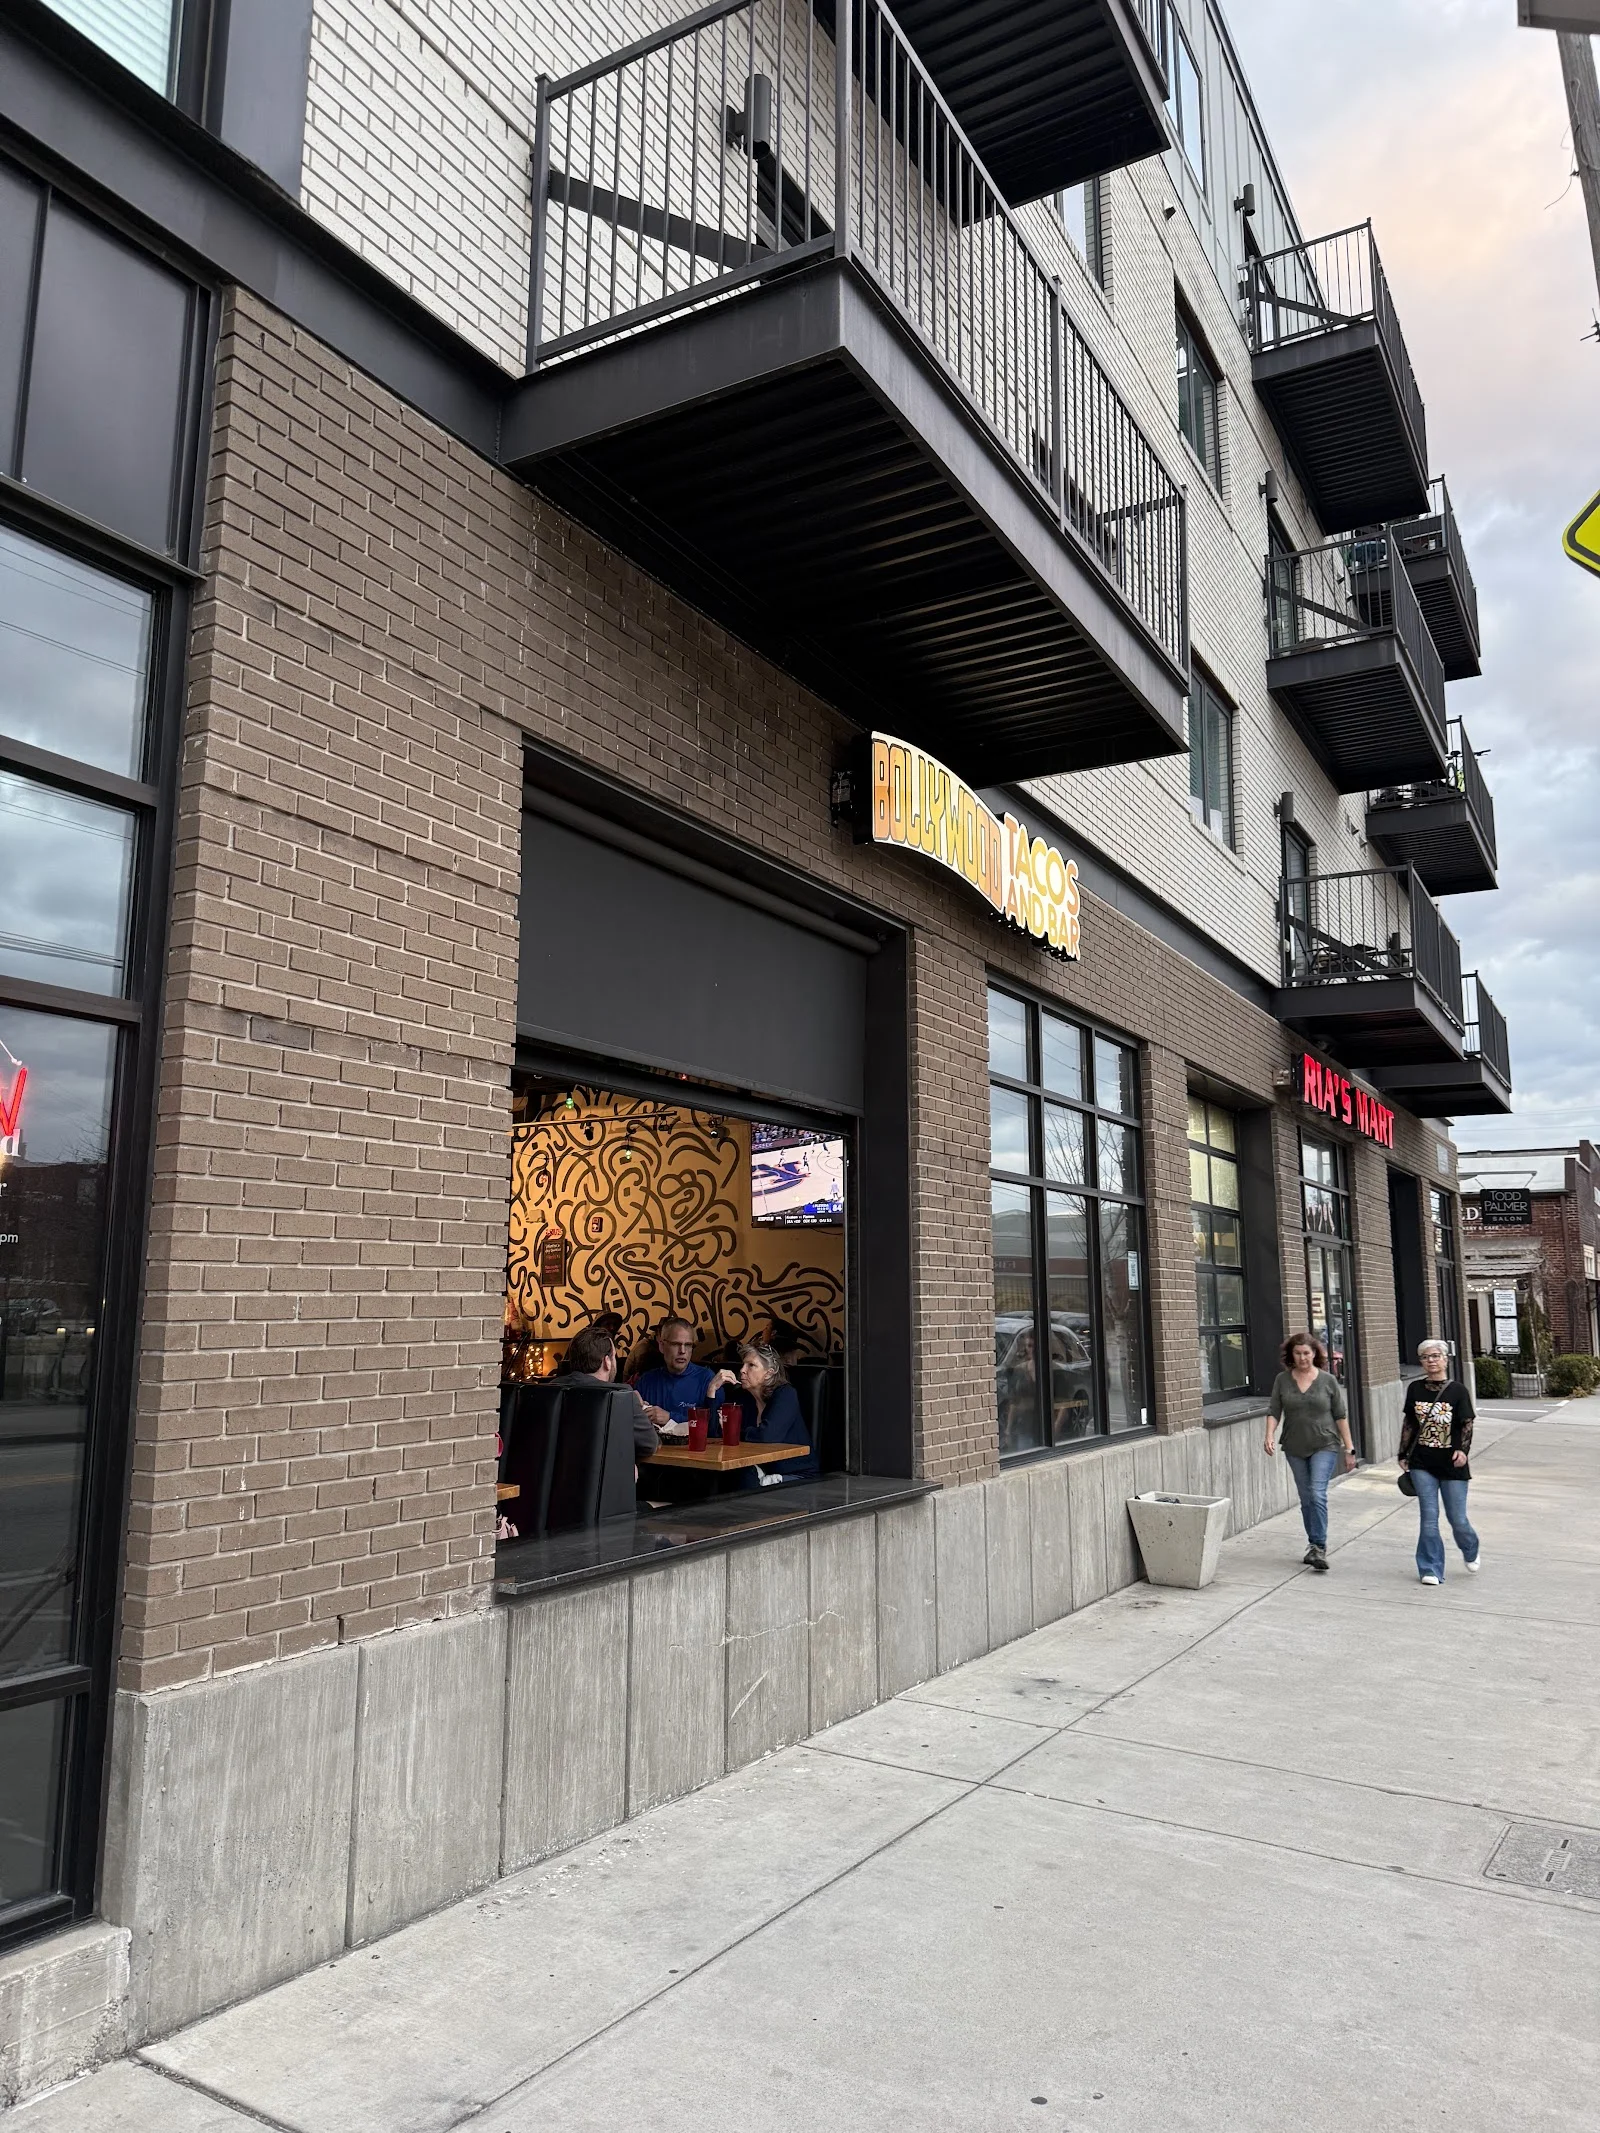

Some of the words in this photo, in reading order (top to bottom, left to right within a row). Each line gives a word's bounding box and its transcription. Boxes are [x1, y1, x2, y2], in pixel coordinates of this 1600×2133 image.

[872, 738, 1002, 910] BOLLYWOOD
[1004, 817, 1079, 915] TACOS
[1005, 878, 1045, 938] AND
[1047, 903, 1081, 961] BAR
[1304, 1053, 1352, 1124] RIA'S
[1355, 1088, 1394, 1149] MART
[832, 1204, 842, 1212] 84
[1484, 1201, 1528, 1212] PALMER
[1491, 1191, 1521, 1201] TODD
